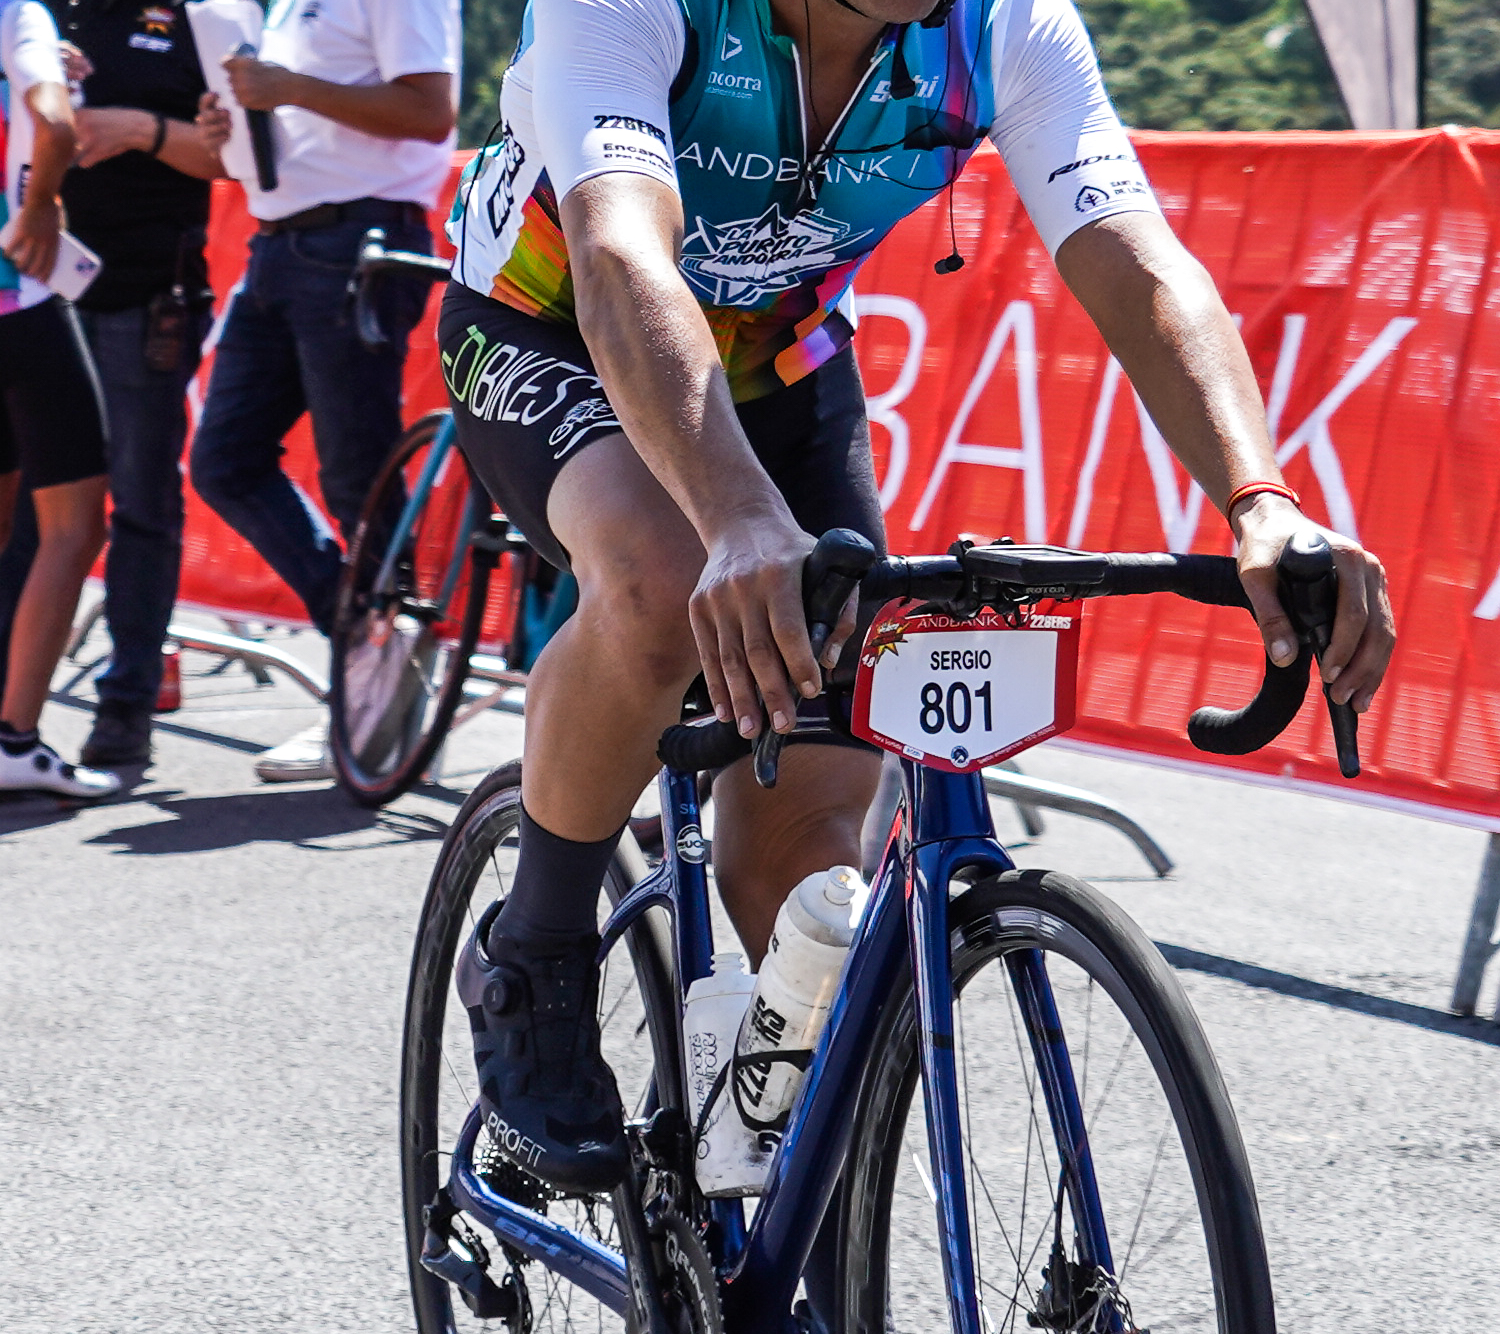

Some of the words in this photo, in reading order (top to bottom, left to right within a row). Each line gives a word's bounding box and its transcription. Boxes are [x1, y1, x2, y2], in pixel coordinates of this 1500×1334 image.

[674, 142, 893, 185] ANDBANK
[727, 228, 751, 241] LA
[719, 236, 813, 255] PURITO
[714, 249, 803, 266] ANDORRA
[1030, 616, 1072, 629] 226ERS
[930, 649, 991, 670] SERGIO
[919, 680, 993, 735] 801
[487, 1111, 547, 1168] PROFIT
